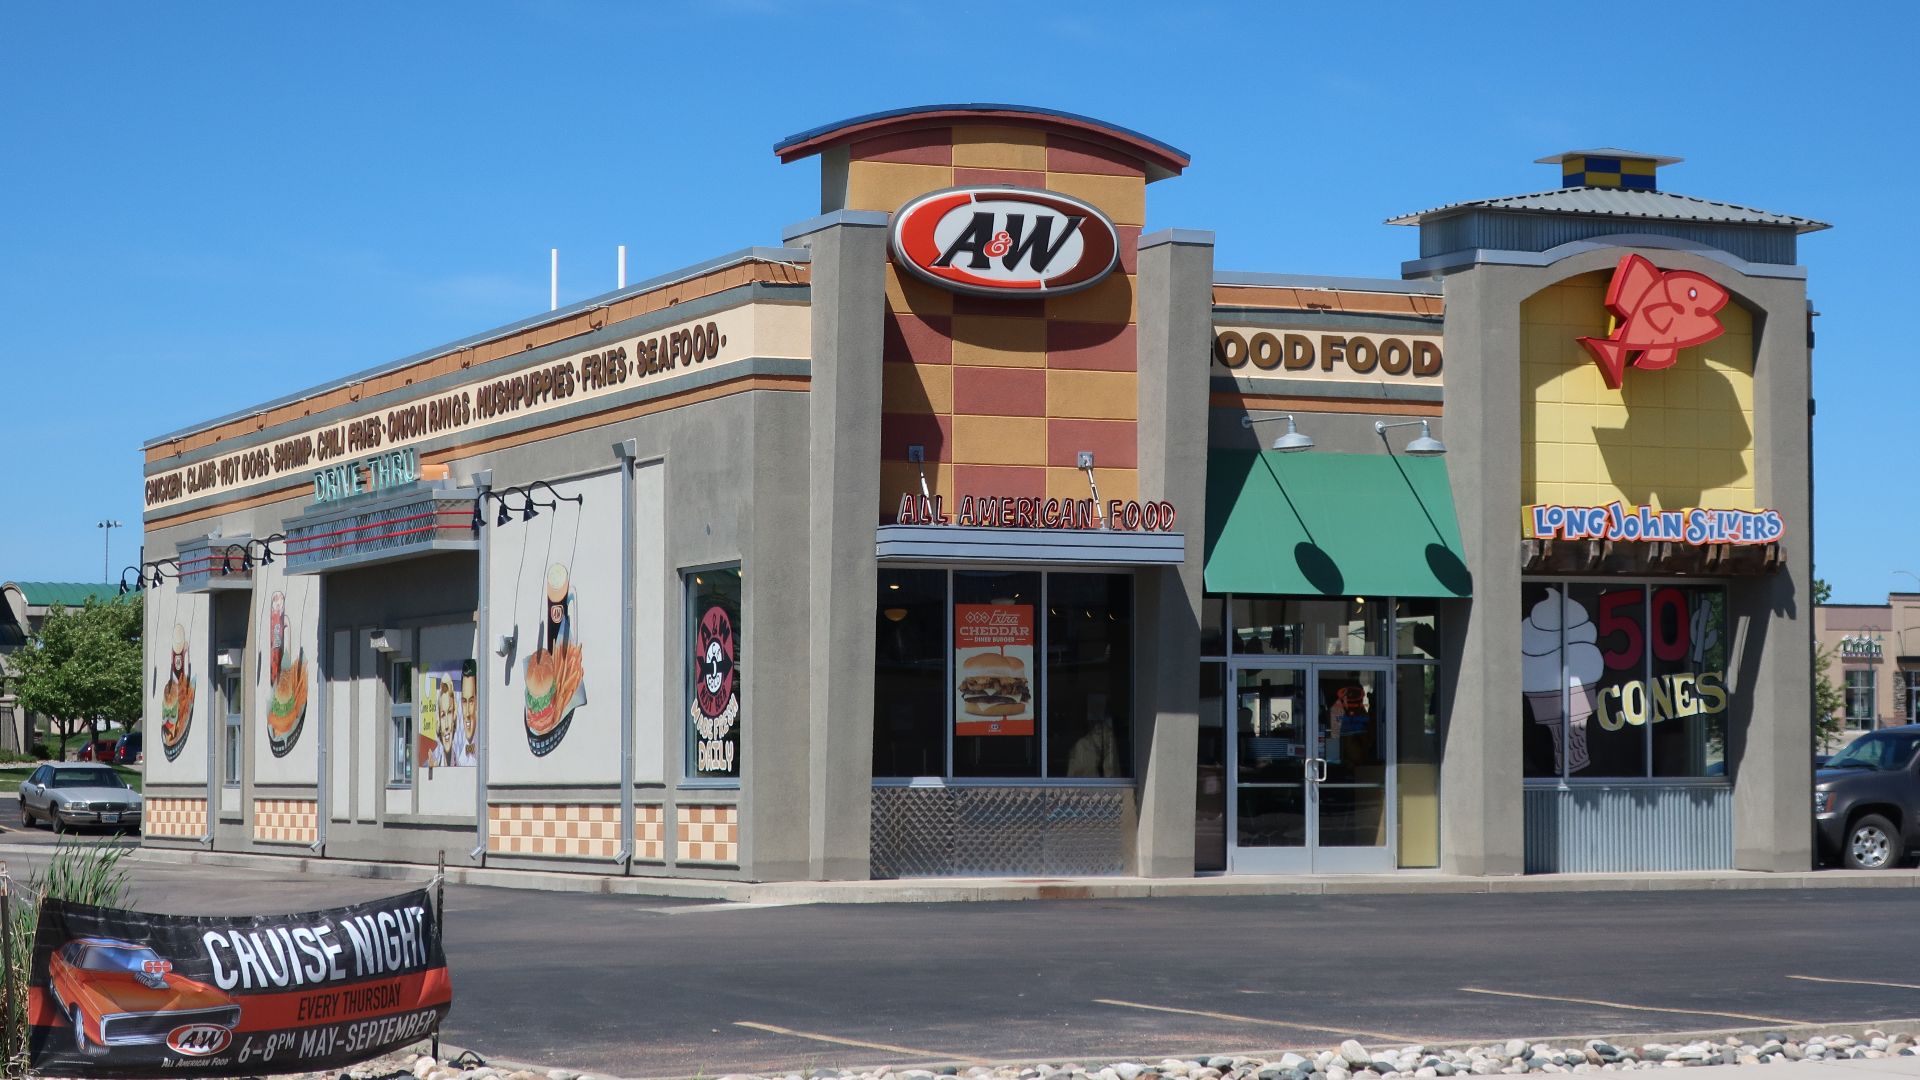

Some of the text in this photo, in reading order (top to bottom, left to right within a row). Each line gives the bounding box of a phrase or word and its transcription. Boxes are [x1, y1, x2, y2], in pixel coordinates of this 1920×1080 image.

[929, 211, 1088, 274] A&W
[1210, 331, 1443, 378] OOD FOOD
[145, 321, 719, 506] CHICKEN CLAMS HOT DOGS SHRIMP CHILI FRIES ONION RINGS HUSHPUPPIES FRIES SEAFOOD
[313, 448, 418, 503] DRIVE THRU
[897, 493, 1176, 532] ALL AMERICAN FOOD
[960, 626, 1029, 636] CHEDDAR
[989, 610, 1020, 625] Extra
[691, 692, 739, 741] MADE FRESH
[1597, 671, 1727, 731] CONES
[698, 740, 734, 772] DAILY
[202, 906, 428, 991] CRUISE NIGHT
[297, 982, 403, 1022] EVERY THURSDAY
[177, 1030, 226, 1050] A&W
[299, 1010, 438, 1060] MAY-SEPTEMBER
